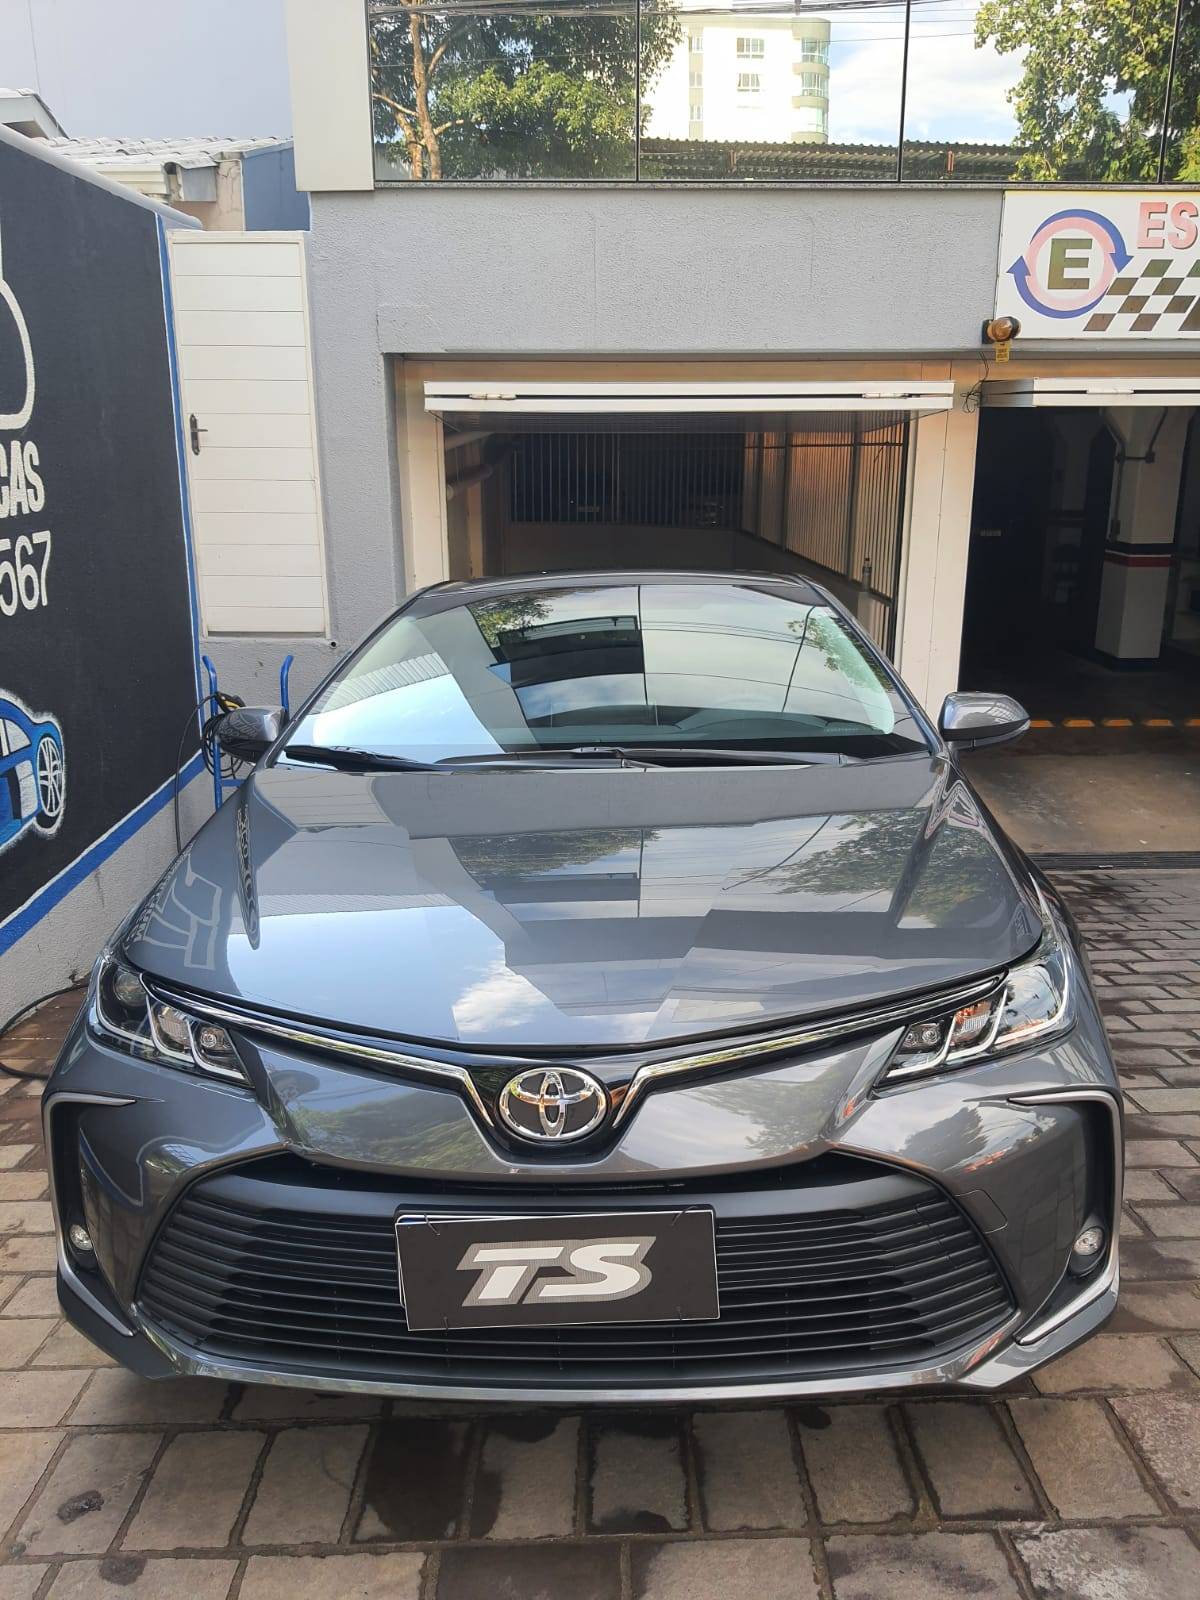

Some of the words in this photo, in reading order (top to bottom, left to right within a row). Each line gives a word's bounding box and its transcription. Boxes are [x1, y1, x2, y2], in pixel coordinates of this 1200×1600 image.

[1137, 201, 1199, 249] ES
[1047, 238, 1093, 290] E
[0, 530, 51, 616] 567
[456, 1236, 656, 1307] TS
